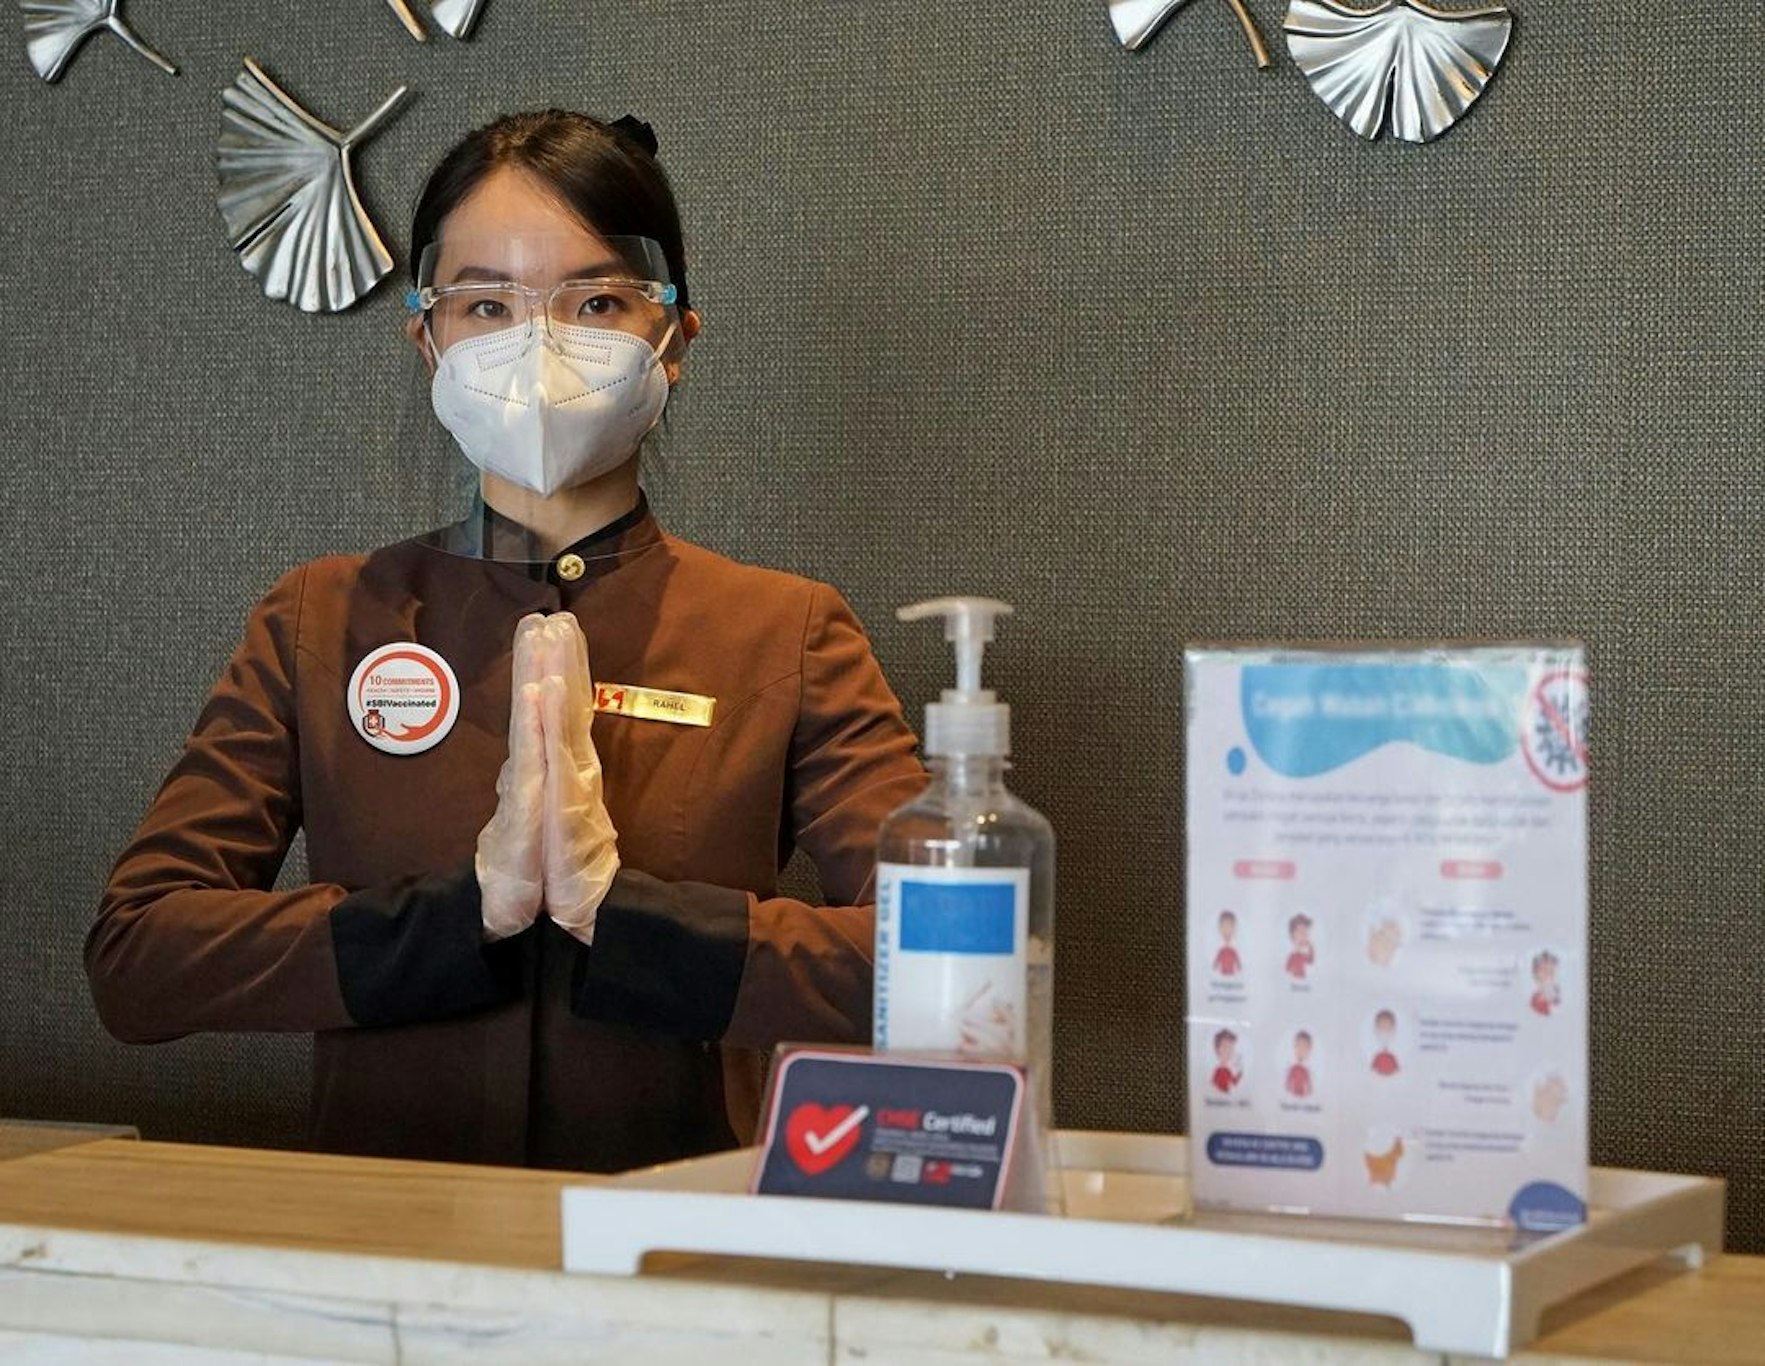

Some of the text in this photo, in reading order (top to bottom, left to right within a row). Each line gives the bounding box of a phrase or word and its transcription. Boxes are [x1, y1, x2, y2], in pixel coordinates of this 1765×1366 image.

[370, 676, 434, 685] 10 COMMITMENTS
[366, 699, 437, 708] #SBIVaccinated
[653, 699, 686, 711] RAHEL
[877, 931, 889, 1050] SANITIZER
[922, 1111, 996, 1136] Certified
